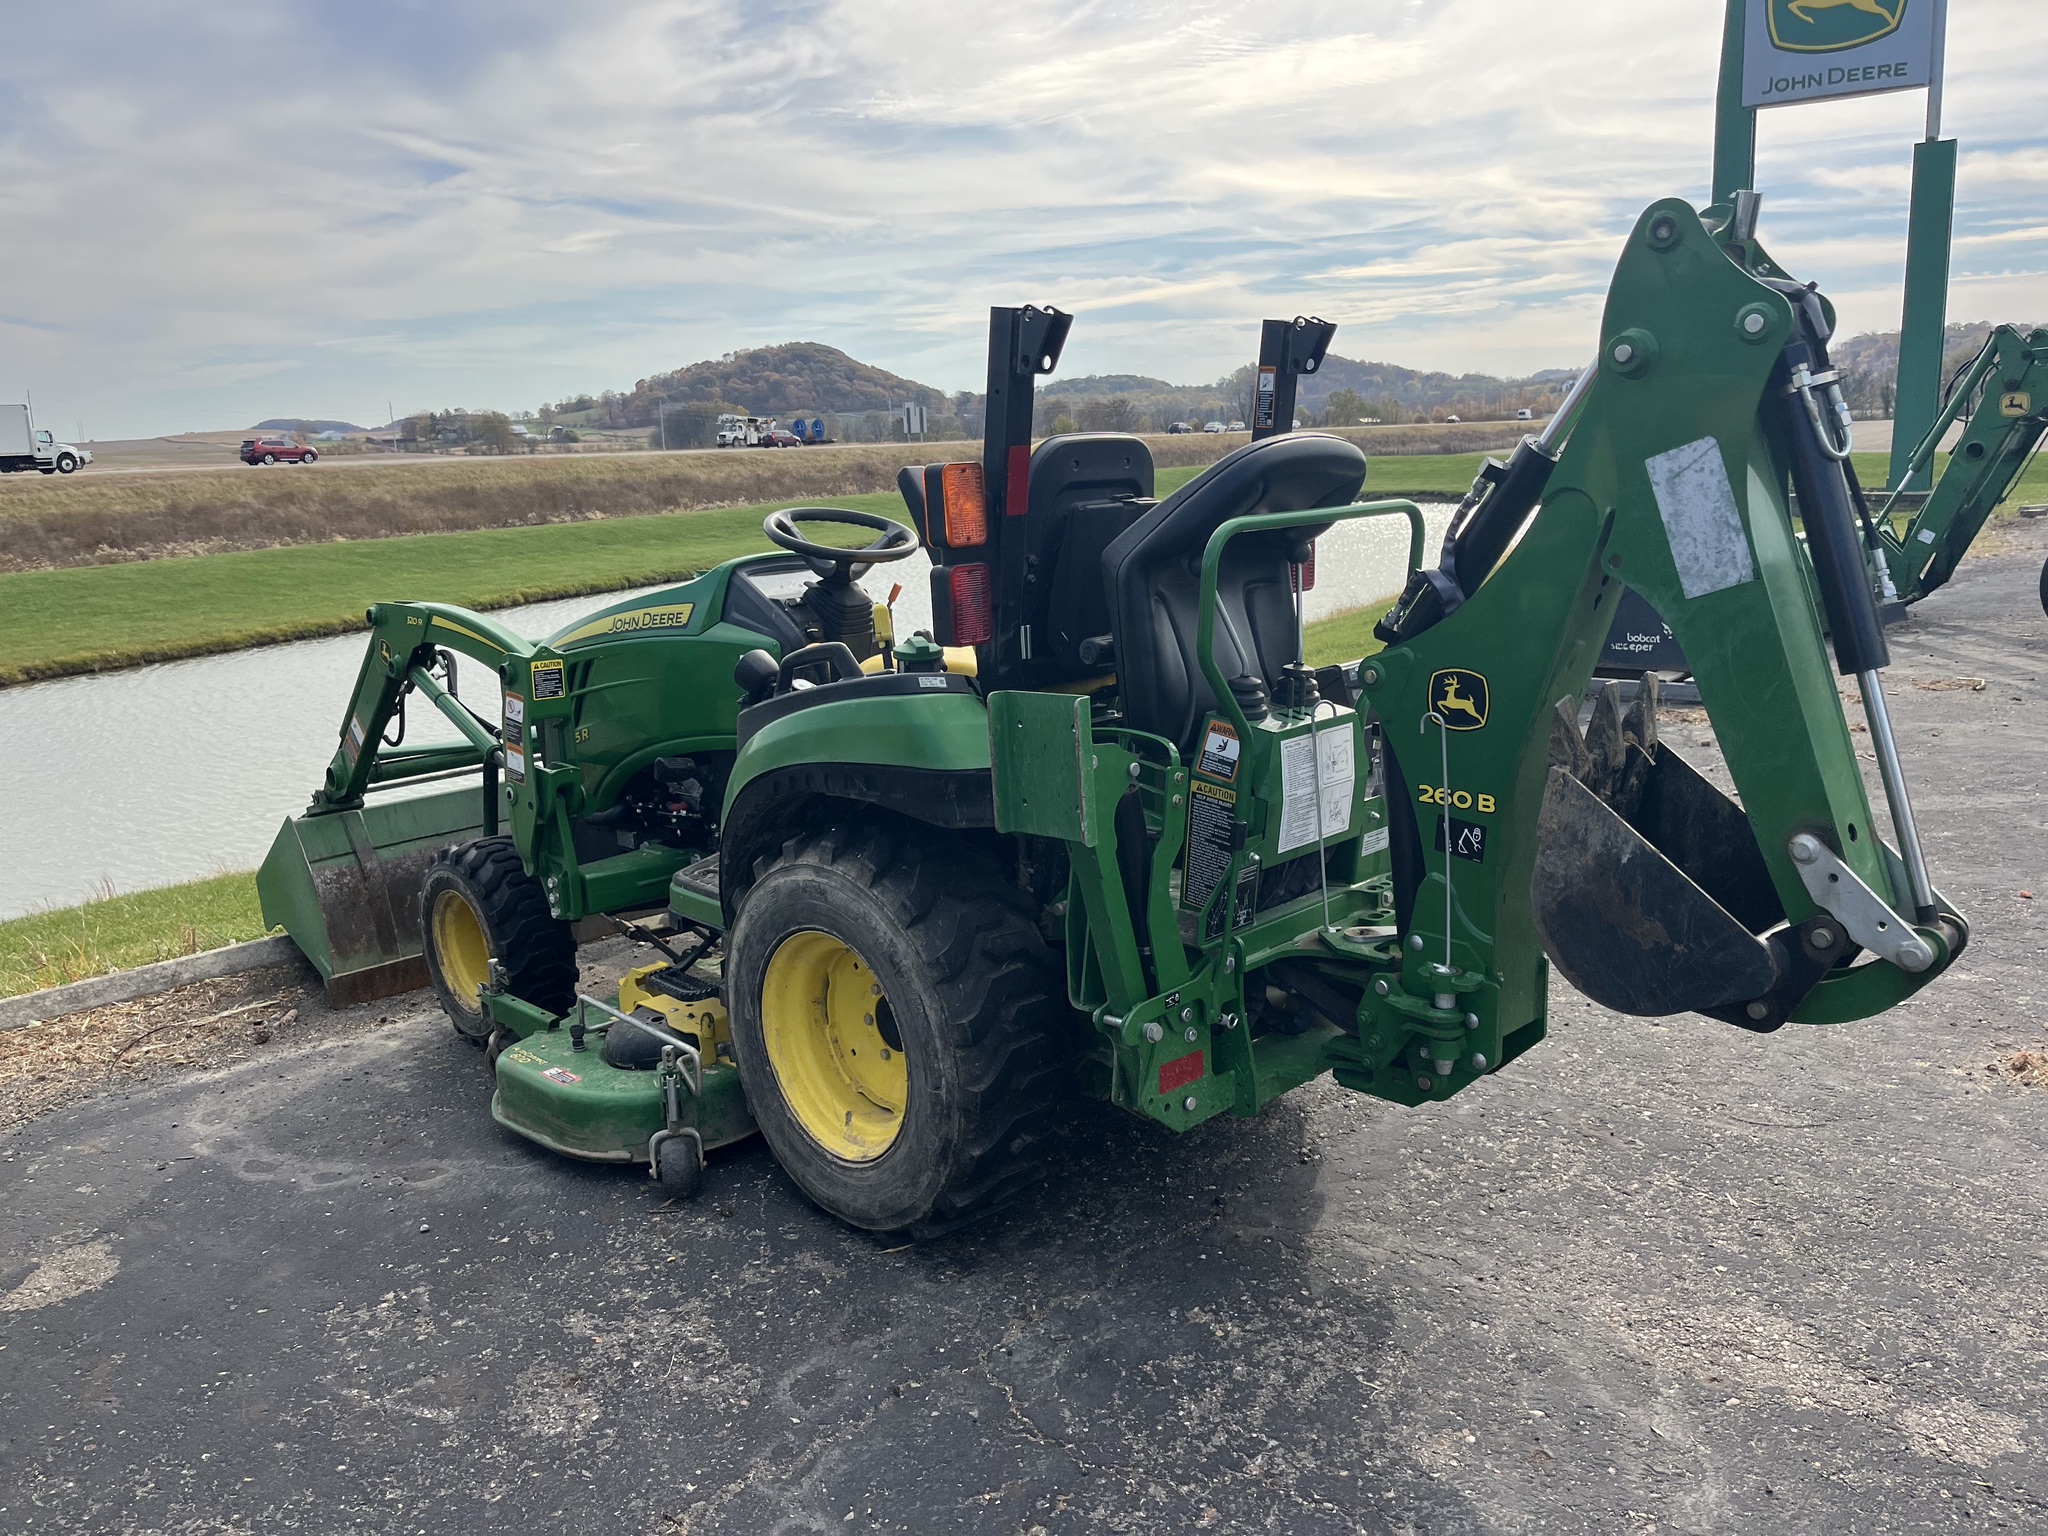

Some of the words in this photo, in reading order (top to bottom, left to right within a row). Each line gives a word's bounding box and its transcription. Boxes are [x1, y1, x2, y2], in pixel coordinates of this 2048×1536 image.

[1761, 73, 1822, 95] JOHN
[1827, 62, 1908, 85] DEERE
[608, 617, 639, 633] JOHN
[642, 612, 684, 627] DEERE
[1626, 632, 1661, 643] bobcat
[540, 661, 562, 669] CAUTION
[1215, 724, 1238, 738] WARN
[1203, 785, 1235, 802] CAUTION
